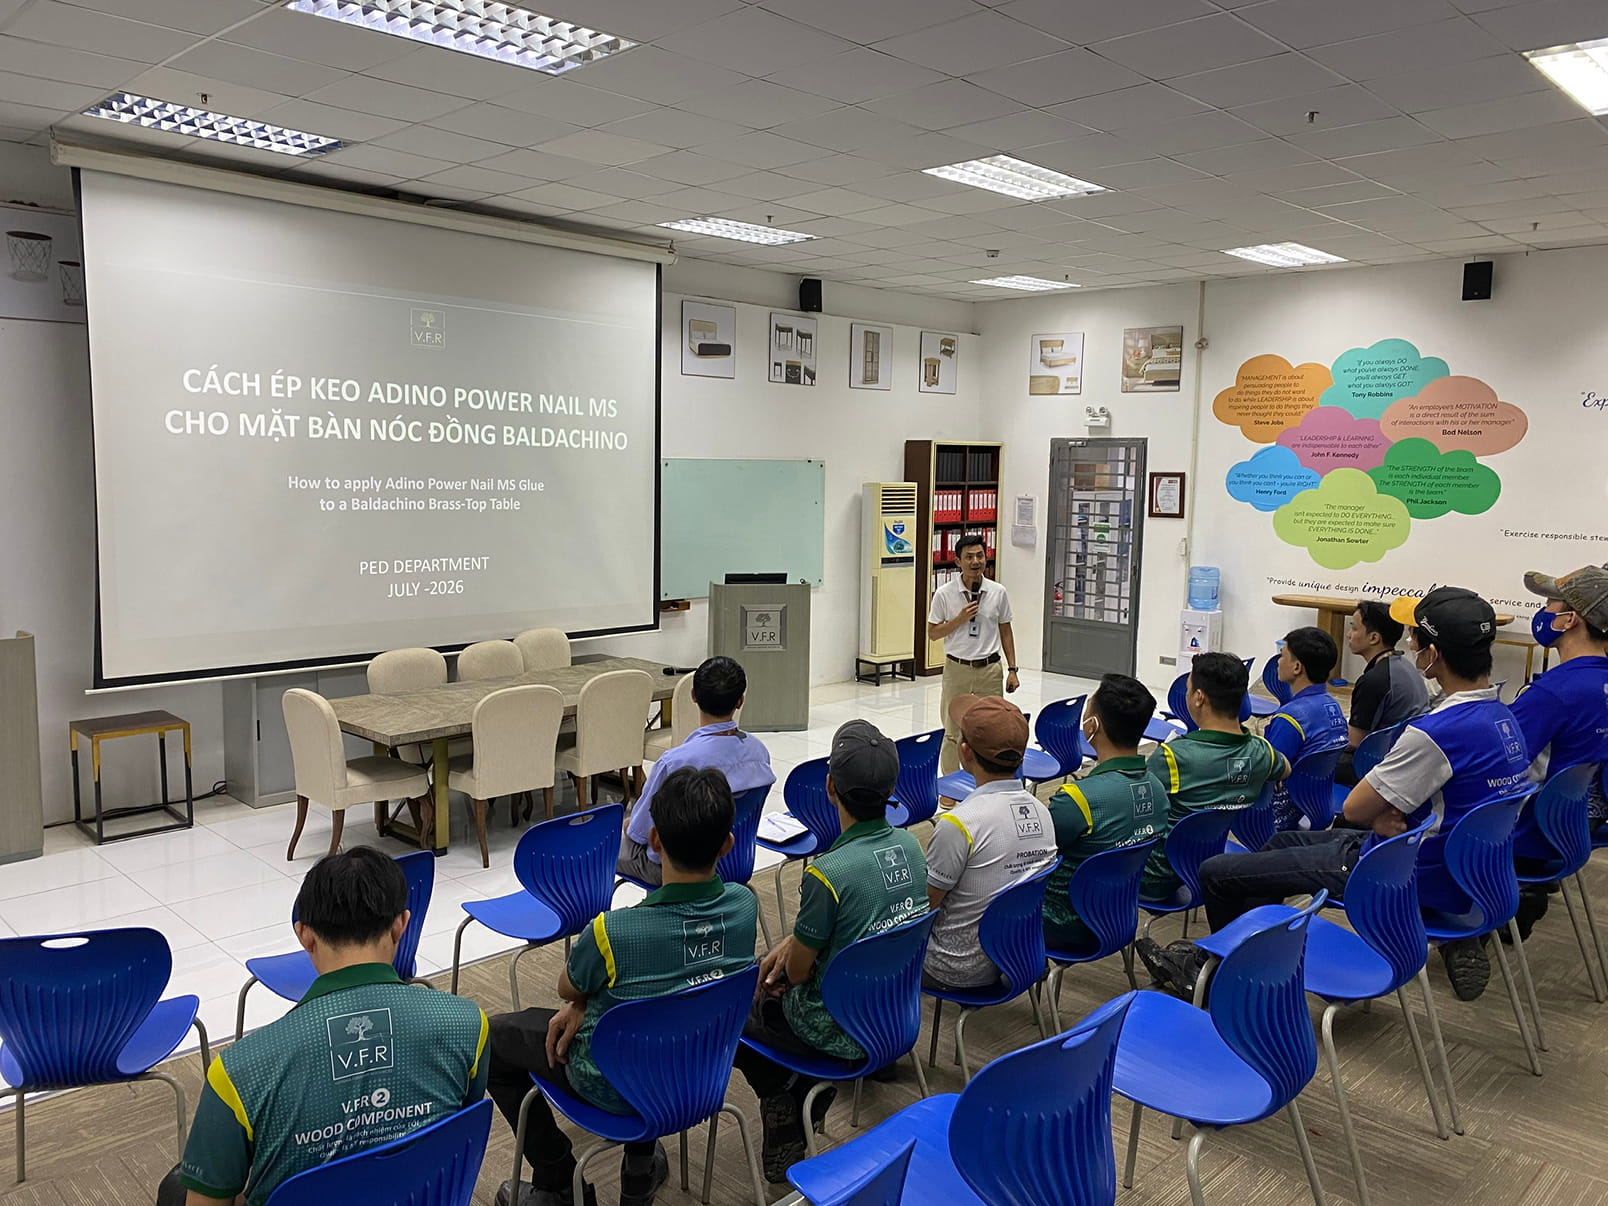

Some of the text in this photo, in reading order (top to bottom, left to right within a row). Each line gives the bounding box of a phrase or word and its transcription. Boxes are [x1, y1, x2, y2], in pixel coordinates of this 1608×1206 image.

[415, 331, 441, 343] V.F.R
[182, 364, 618, 418] CÁCH ÉP KEO ADINO POWER NAIL MS
[164, 408, 628, 450] CHO MẶT BÀN NÓC ĐỒNG BALDACHINO
[288, 475, 545, 492] How to apply Adino Power Nail MS Glue
[320, 497, 520, 512] to a Baldachino Brass-Top Table
[359, 556, 490, 575] PED DEPARTMENT
[387, 579, 464, 598] JULY -2026
[1298, 582, 1331, 591] unique
[1334, 584, 1358, 593] design
[1490, 599, 1522, 607] service
[752, 632, 776, 641] V.F.R
[1018, 823, 1040, 832] V.F.R
[1017, 849, 1047, 858] PROBATION
[886, 869, 908, 883] V.F.R
[890, 902, 905, 913] V.F.R
[689, 940, 720, 958] V.F.R
[338, 1046, 387, 1069] V.F.R
[295, 1102, 432, 1145] WOOD COMPONENT
